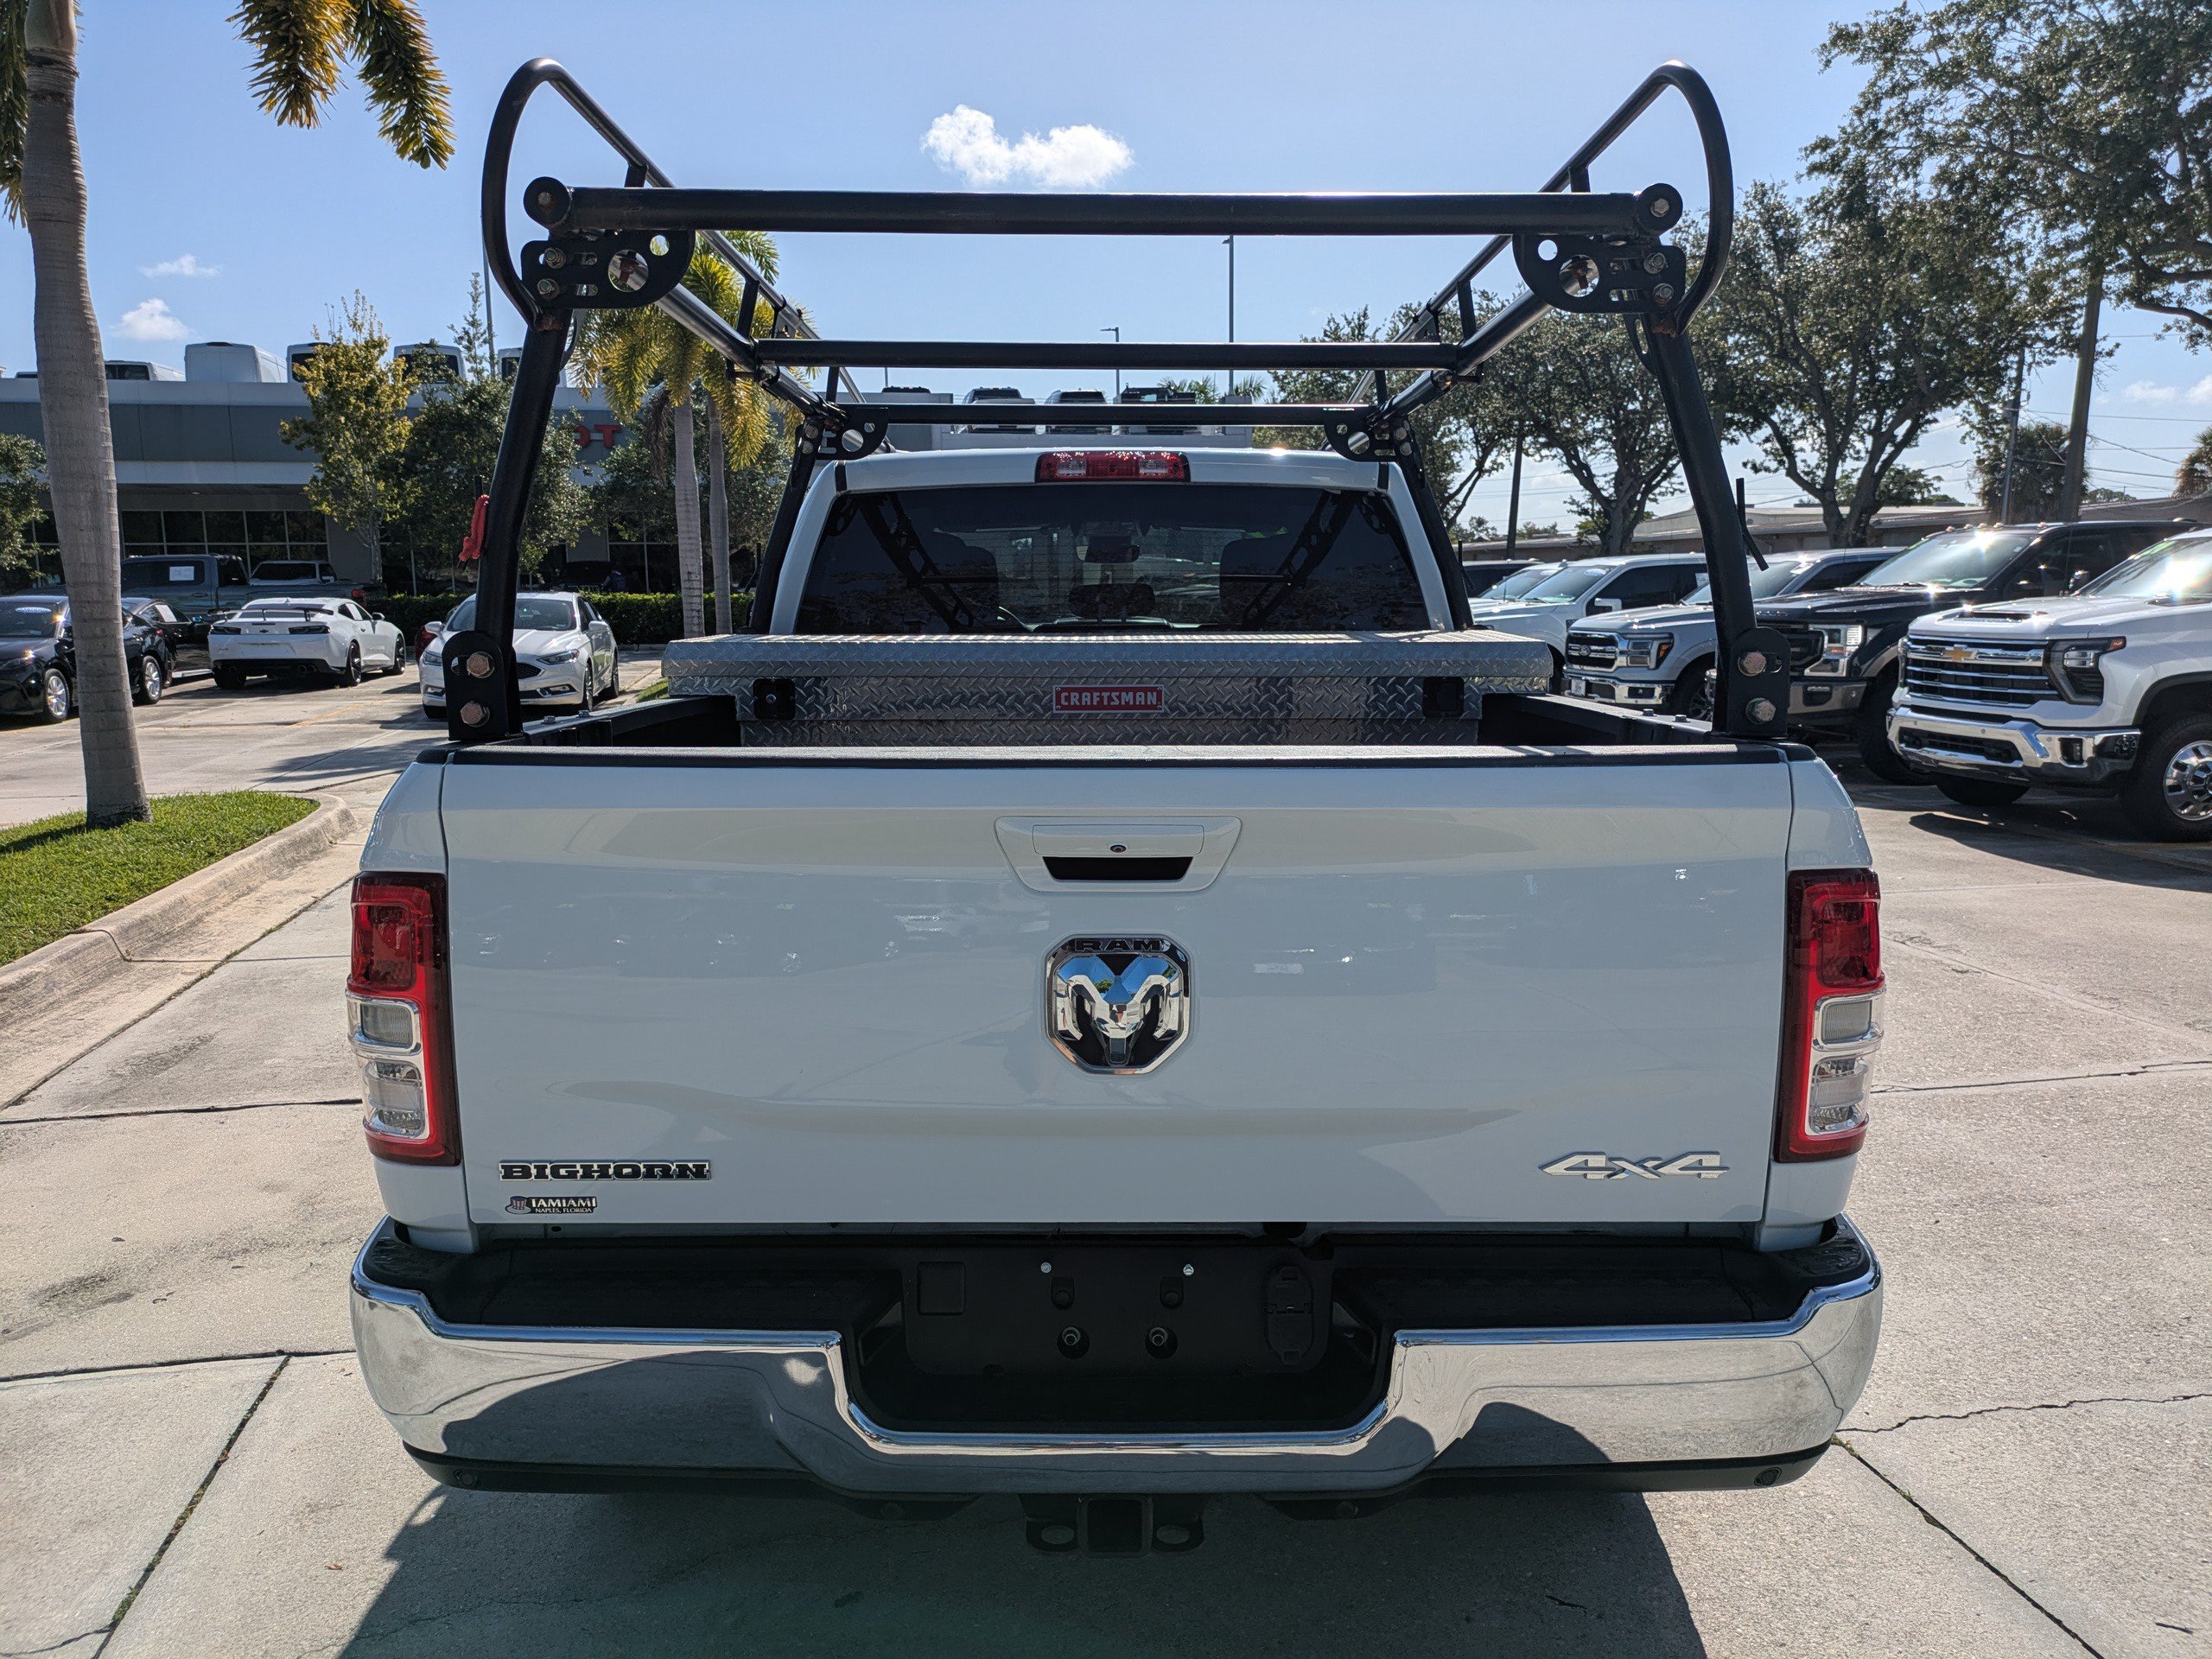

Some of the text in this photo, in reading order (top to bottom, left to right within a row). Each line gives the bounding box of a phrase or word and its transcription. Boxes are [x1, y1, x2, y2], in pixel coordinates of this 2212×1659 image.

[1060, 691, 1158, 706] CRAFTSMAN
[1074, 939, 1162, 951] RAM
[499, 1160, 712, 1181] BIGHORN
